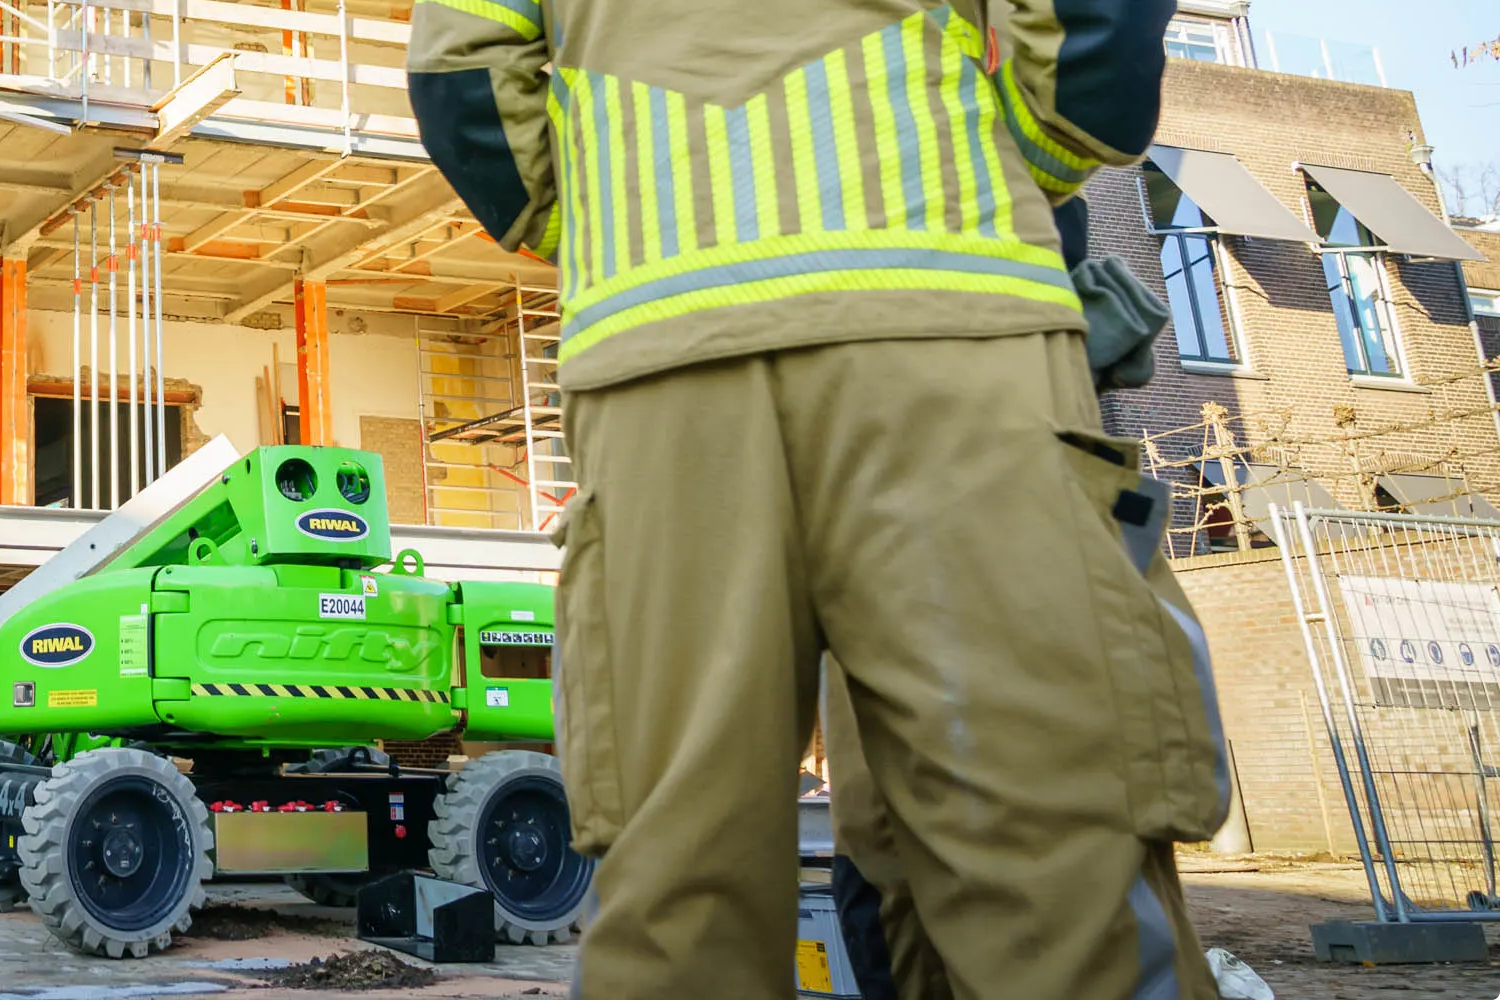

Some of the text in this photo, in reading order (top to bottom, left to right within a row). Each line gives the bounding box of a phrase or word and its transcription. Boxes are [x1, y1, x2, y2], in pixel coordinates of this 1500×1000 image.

[309, 518, 360, 532] RIWAL
[321, 599, 364, 614] E20044
[32, 636, 84, 654] RIWAL
[211, 626, 438, 672] nifty
